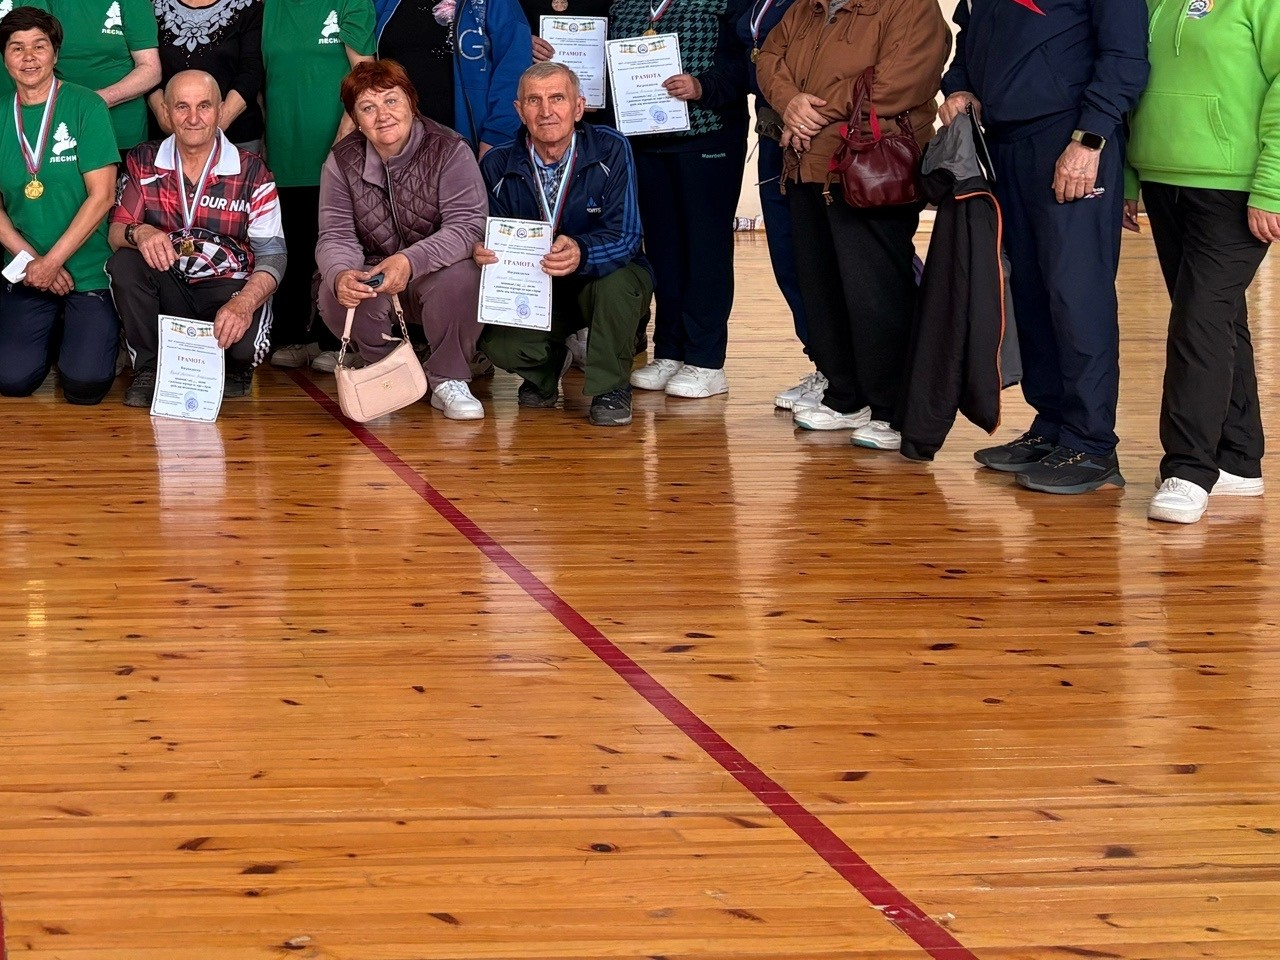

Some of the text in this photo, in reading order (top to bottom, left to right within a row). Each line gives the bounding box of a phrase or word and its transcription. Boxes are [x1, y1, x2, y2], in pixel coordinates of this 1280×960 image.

[631, 73, 662, 81] ГРАМОТА
[50, 155, 77, 163] ЛЕСНИ
[200, 195, 227, 210] OUR
[503, 259, 535, 268] ГРАМОТА
[177, 355, 206, 365] ГРАМОТА
